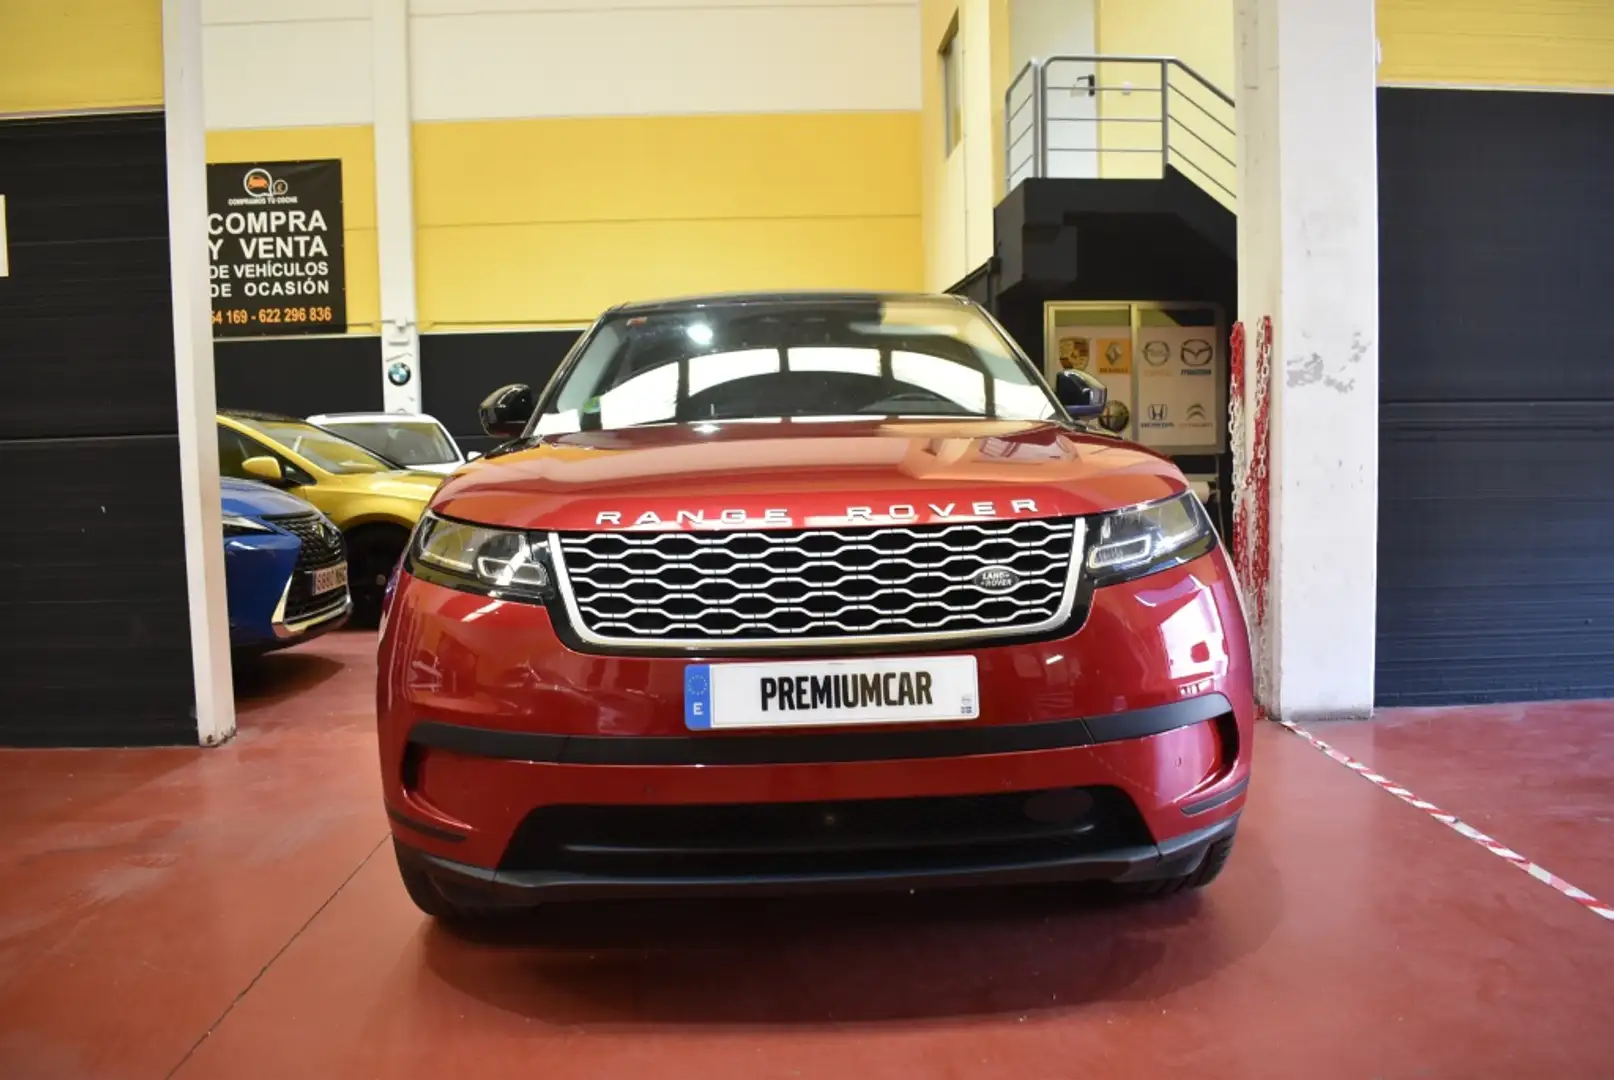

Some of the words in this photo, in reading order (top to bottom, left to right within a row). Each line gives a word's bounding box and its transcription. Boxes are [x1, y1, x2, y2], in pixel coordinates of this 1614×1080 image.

[208, 209, 328, 235] COMPRA
[208, 238, 224, 260] Y
[239, 235, 329, 260] VENTA
[210, 265, 230, 279] DE
[234, 260, 329, 279] VEHÍCULOS
[211, 283, 232, 298] DE
[244, 277, 330, 297] OCASIÓN
[226, 309, 248, 324] 169
[259, 308, 281, 323] 622
[284, 307, 306, 322] 296
[309, 306, 332, 321] 836
[596, 508, 788, 525] RANGE
[846, 498, 1039, 521] ROVER
[760, 671, 933, 711] PREMIUMCAR
[693, 702, 704, 716] E
